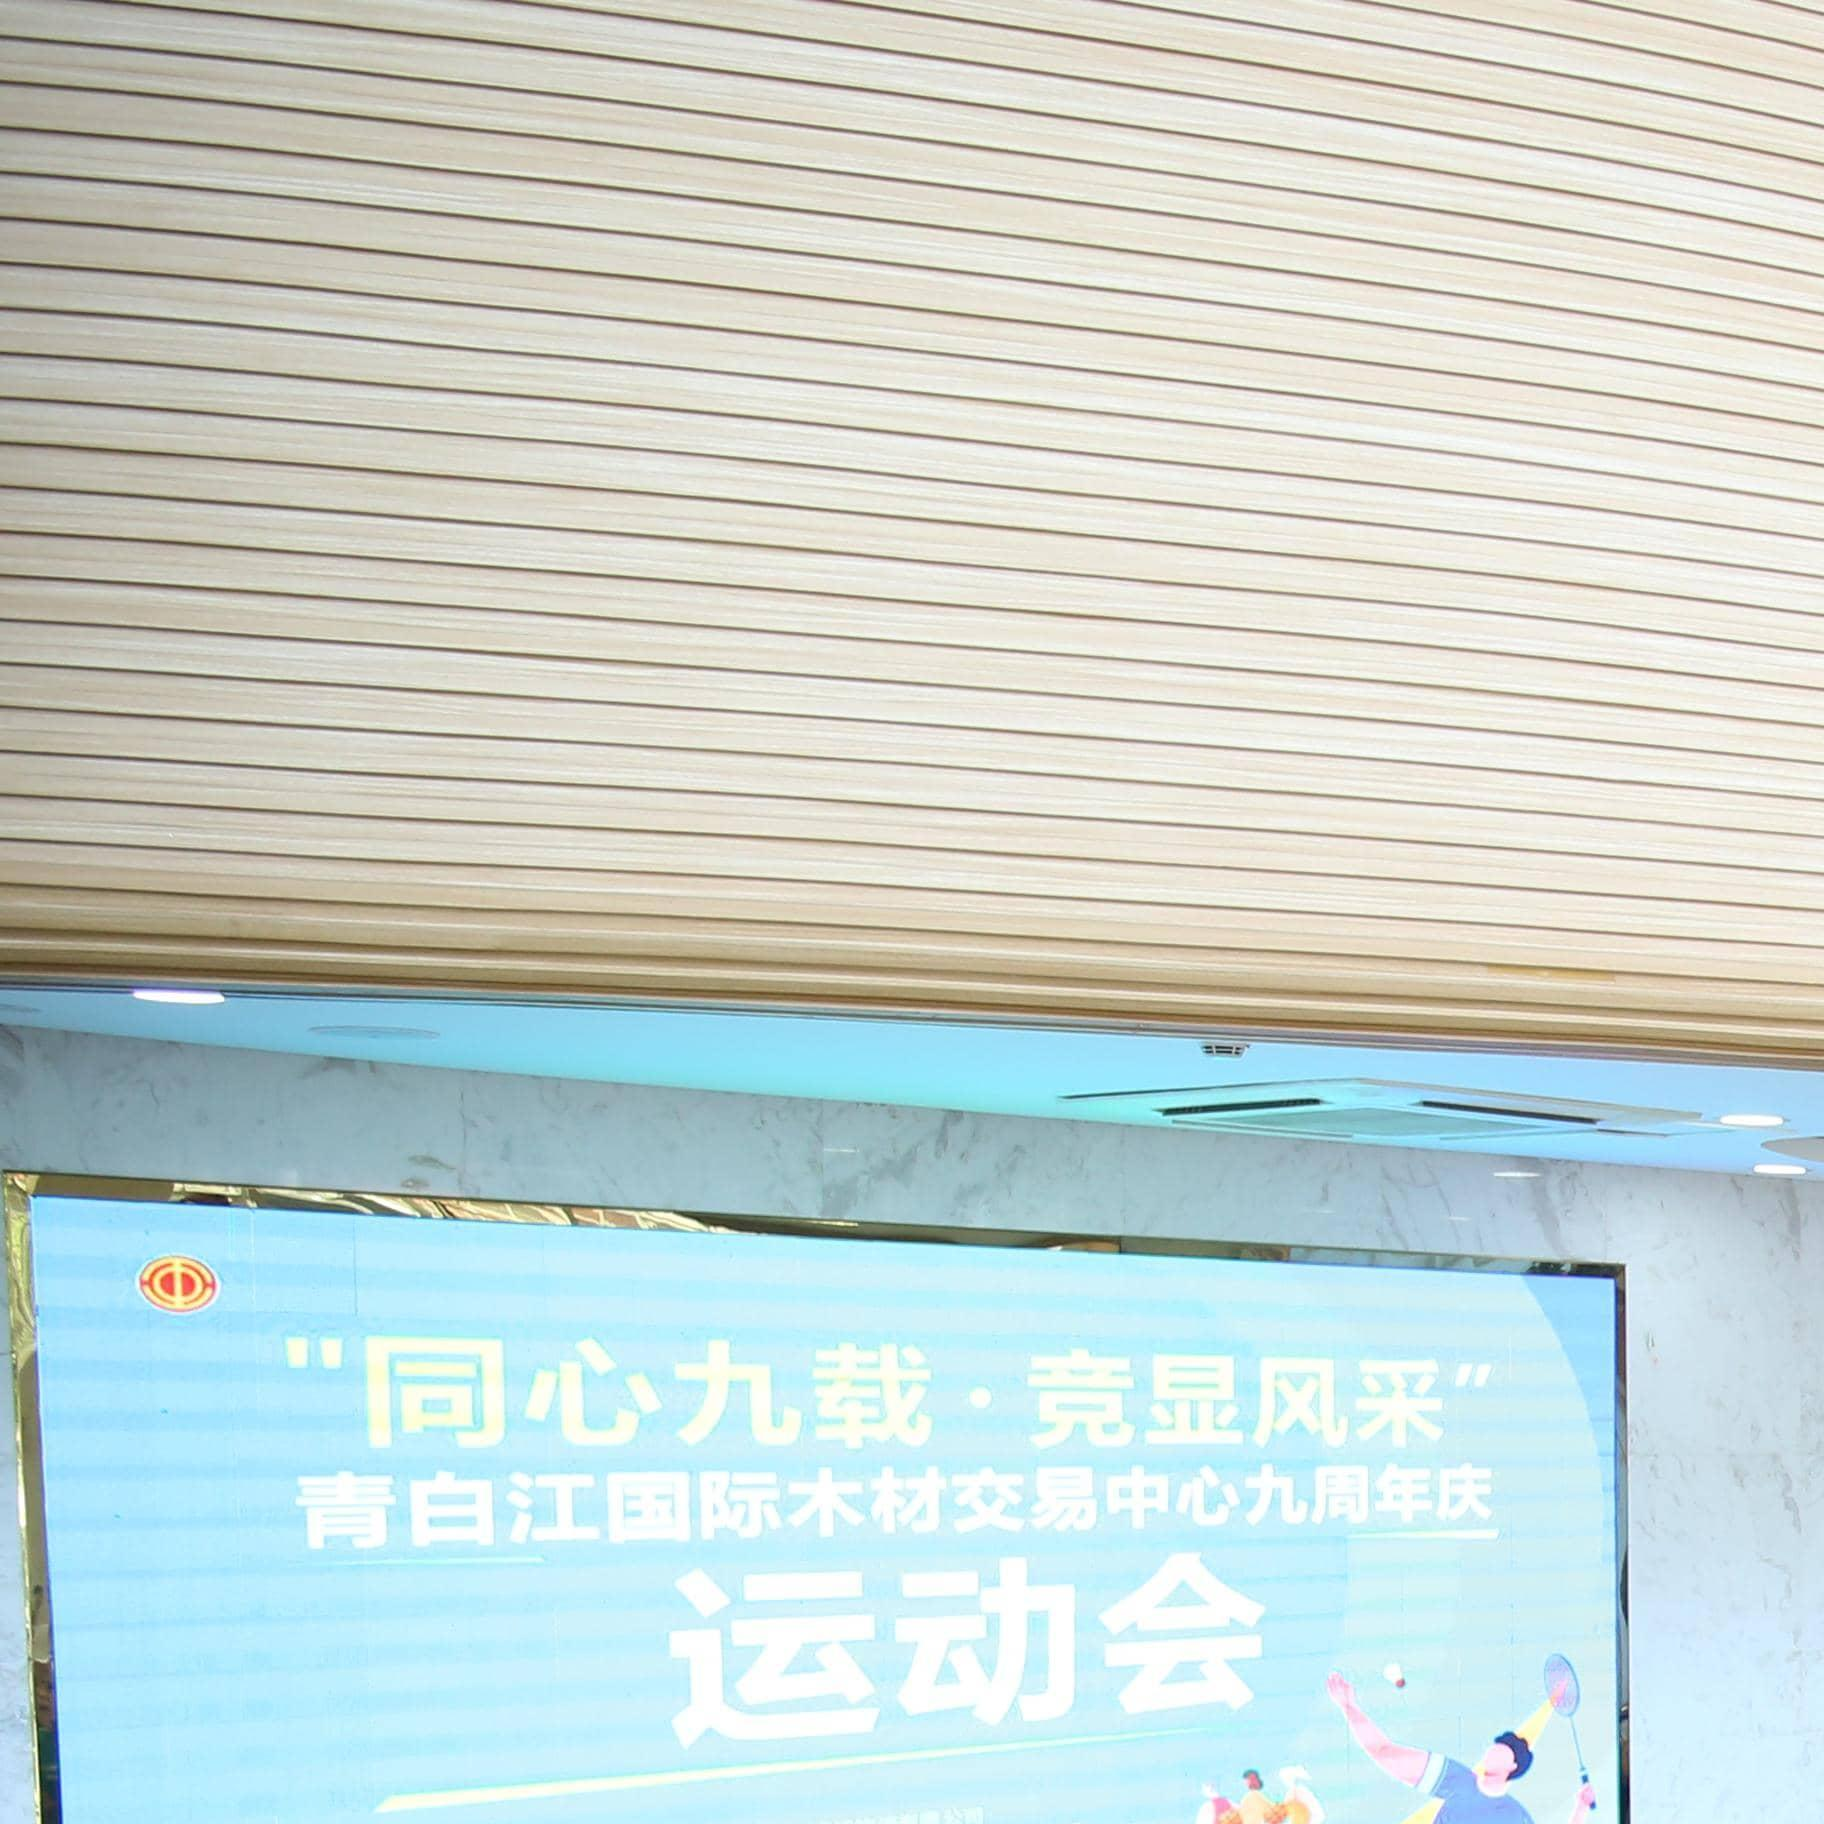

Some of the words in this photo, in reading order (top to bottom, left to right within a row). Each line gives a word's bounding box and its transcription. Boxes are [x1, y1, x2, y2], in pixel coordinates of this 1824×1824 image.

[297, 1464, 1494, 1549] 青白江国际木材交易中心九周年庆
[669, 1551, 1266, 1749] 运动会
